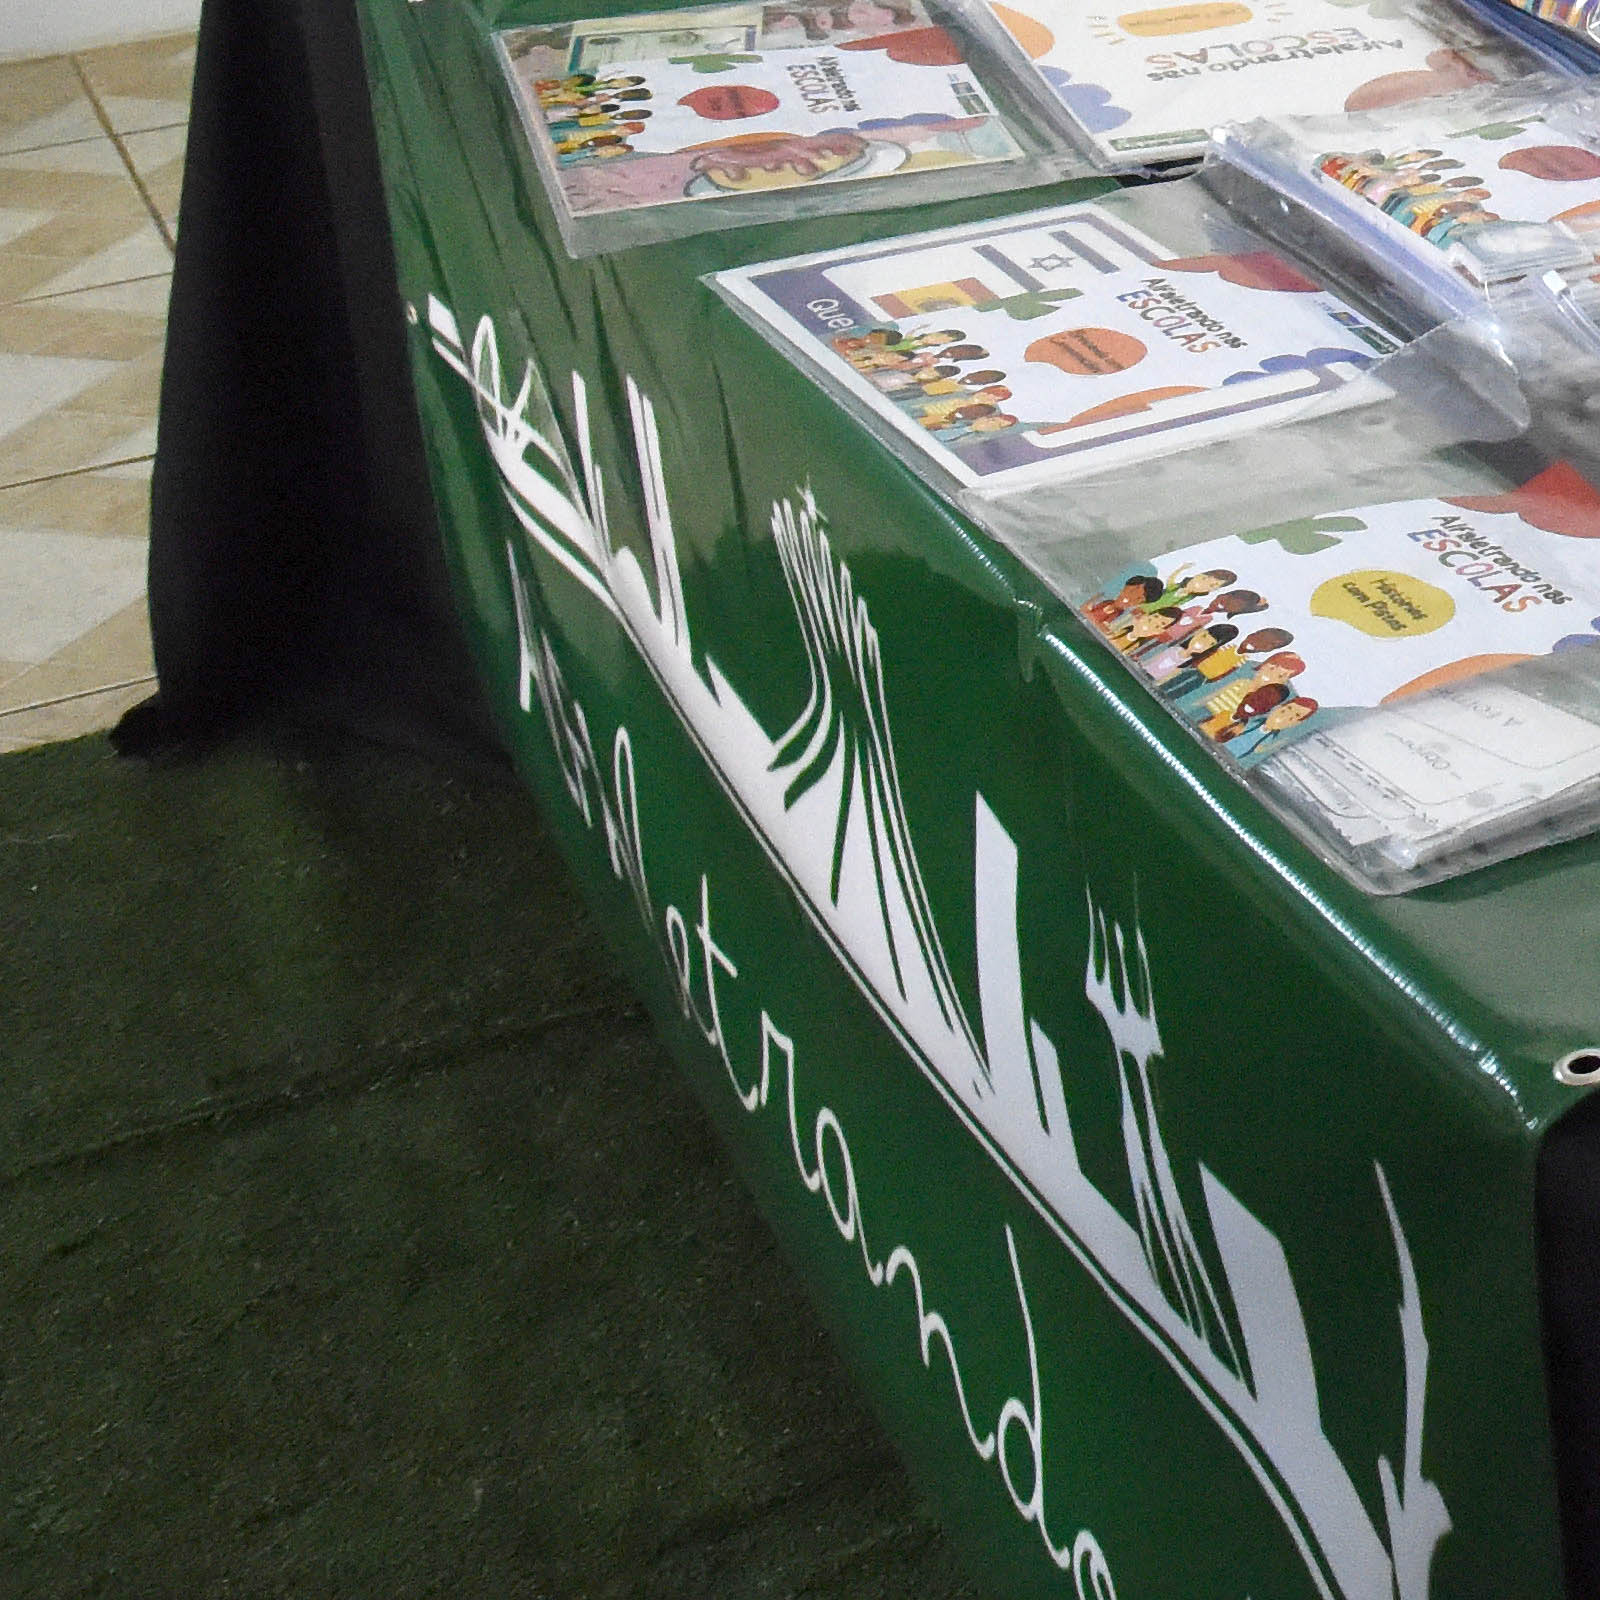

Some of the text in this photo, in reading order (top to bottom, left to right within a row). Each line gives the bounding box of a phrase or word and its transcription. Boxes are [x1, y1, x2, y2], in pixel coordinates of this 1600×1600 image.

[1145, 26, 1368, 70] ESCOLAS
[1116, 289, 1222, 353] ESCOLAS
[1215, 331, 1249, 349] nas
[1406, 528, 1547, 614] ESCOLAS
[1431, 514, 1574, 606] Alfaletrando nas
